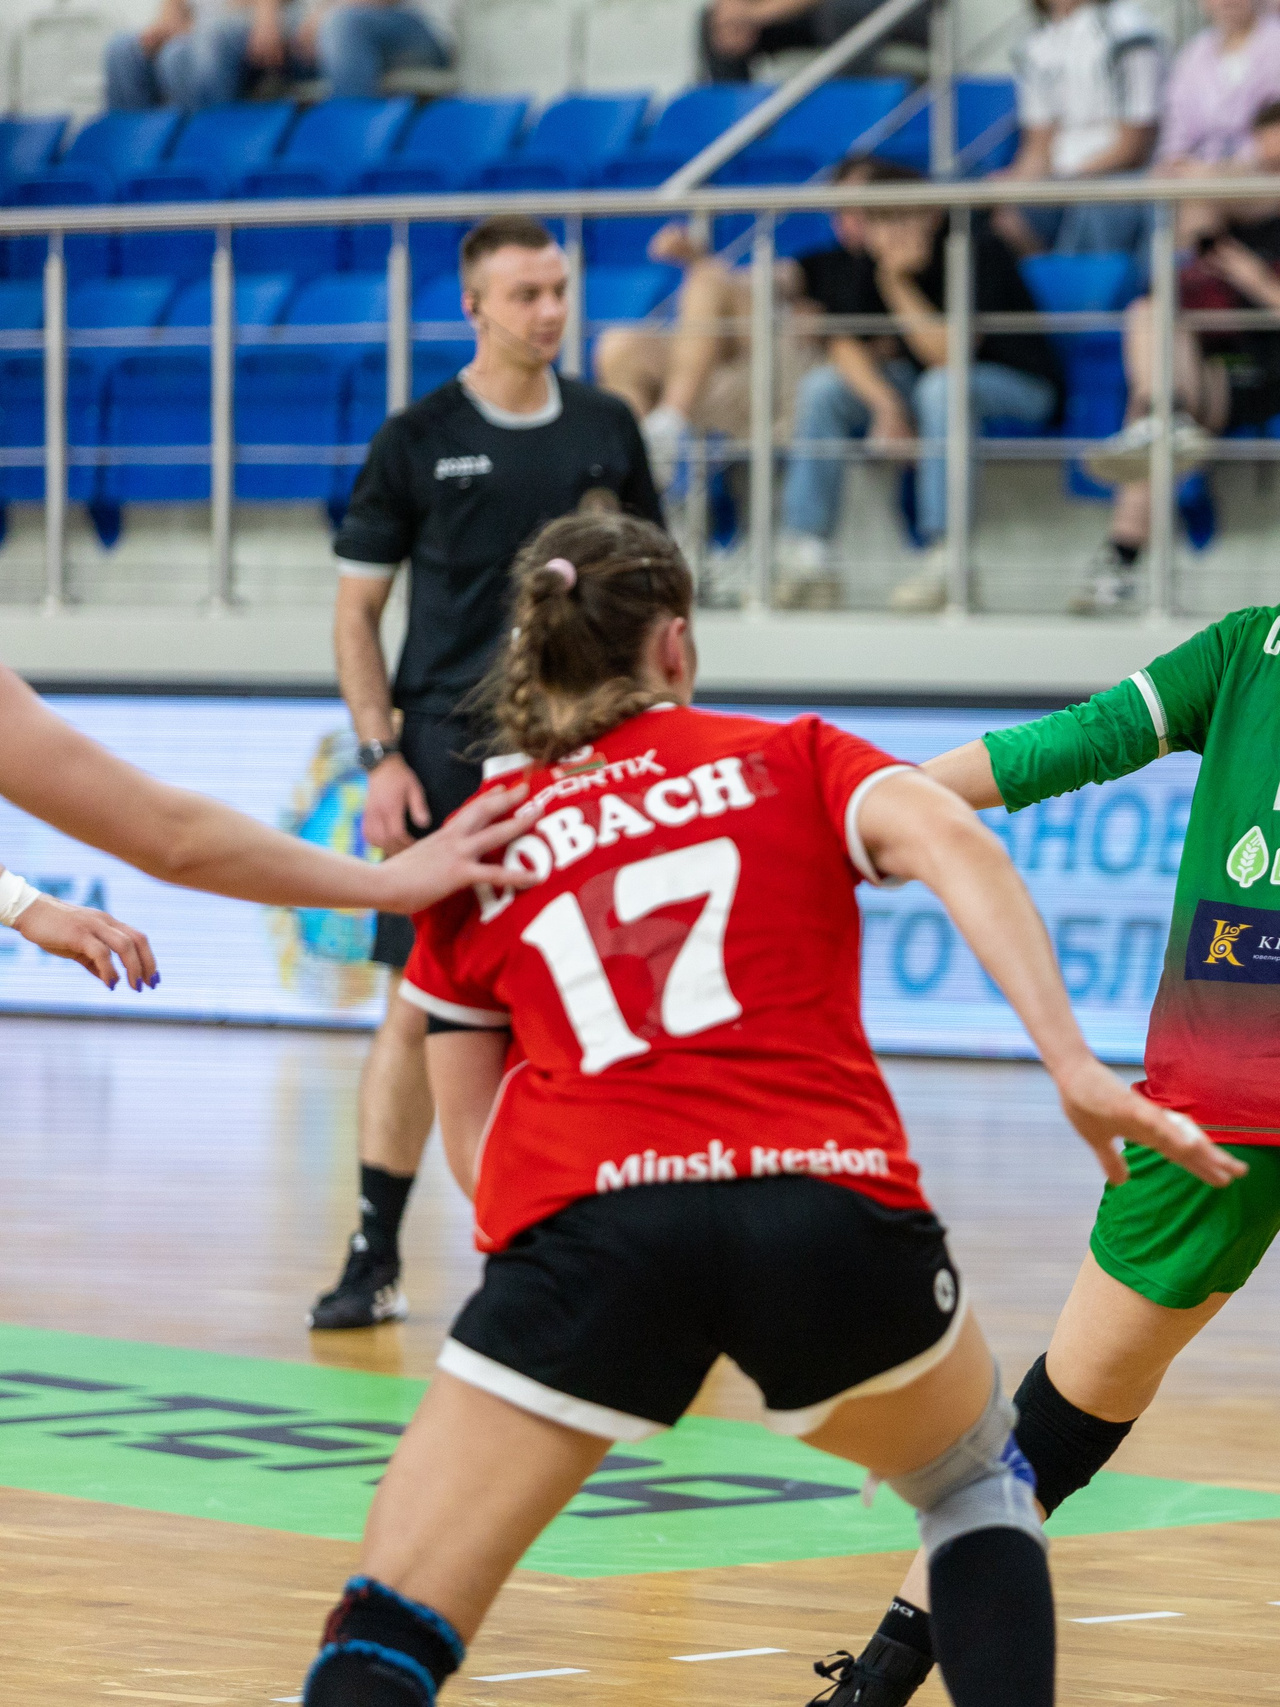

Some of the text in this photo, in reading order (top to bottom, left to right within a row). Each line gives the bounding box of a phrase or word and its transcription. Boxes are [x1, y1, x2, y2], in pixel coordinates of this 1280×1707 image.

[520, 836, 743, 1075] 17
[595, 1139, 890, 1193] Minsk Region
